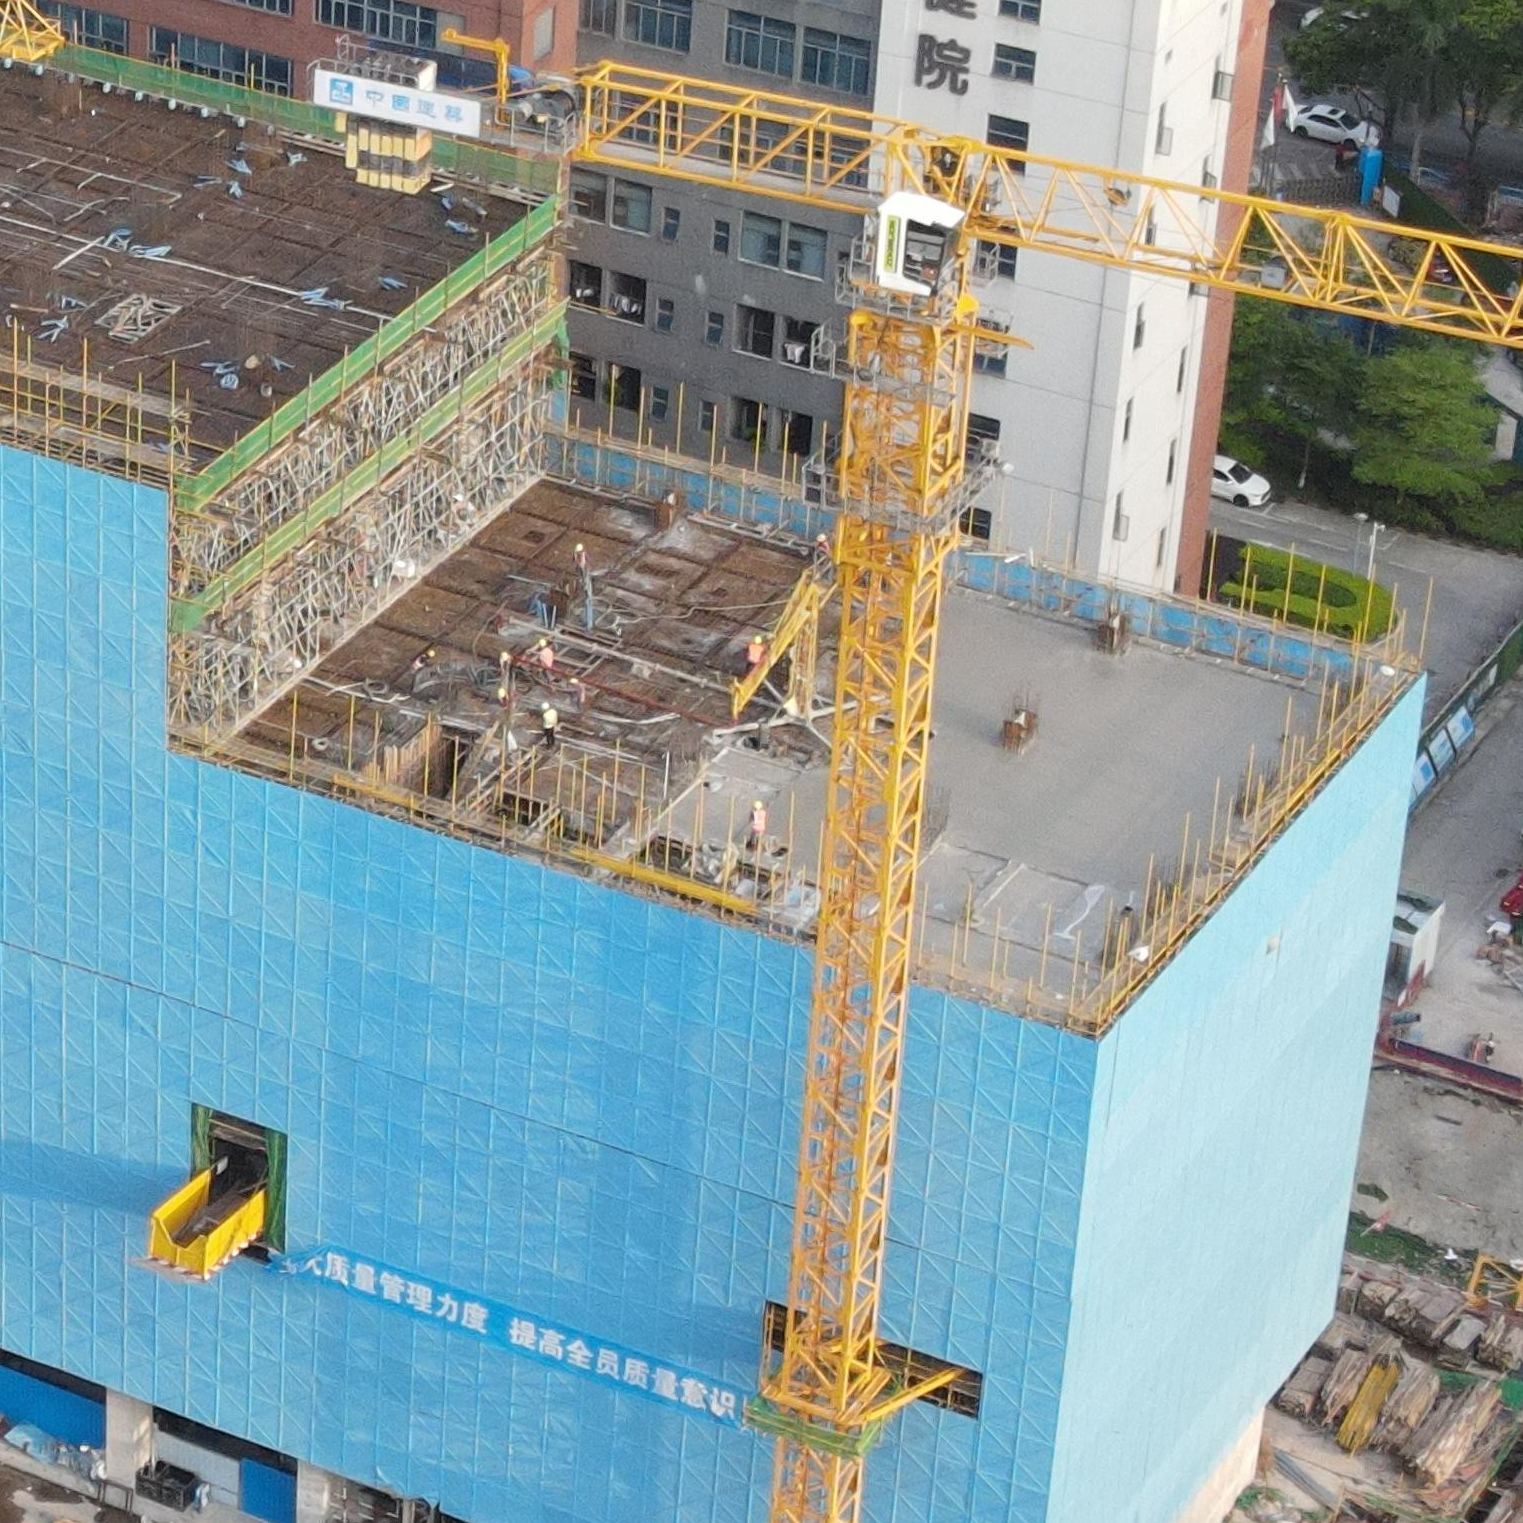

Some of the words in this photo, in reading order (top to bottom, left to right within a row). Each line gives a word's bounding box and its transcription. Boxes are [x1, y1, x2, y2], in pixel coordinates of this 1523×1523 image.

[509, 1317, 736, 1420] 提高全员质量意识
